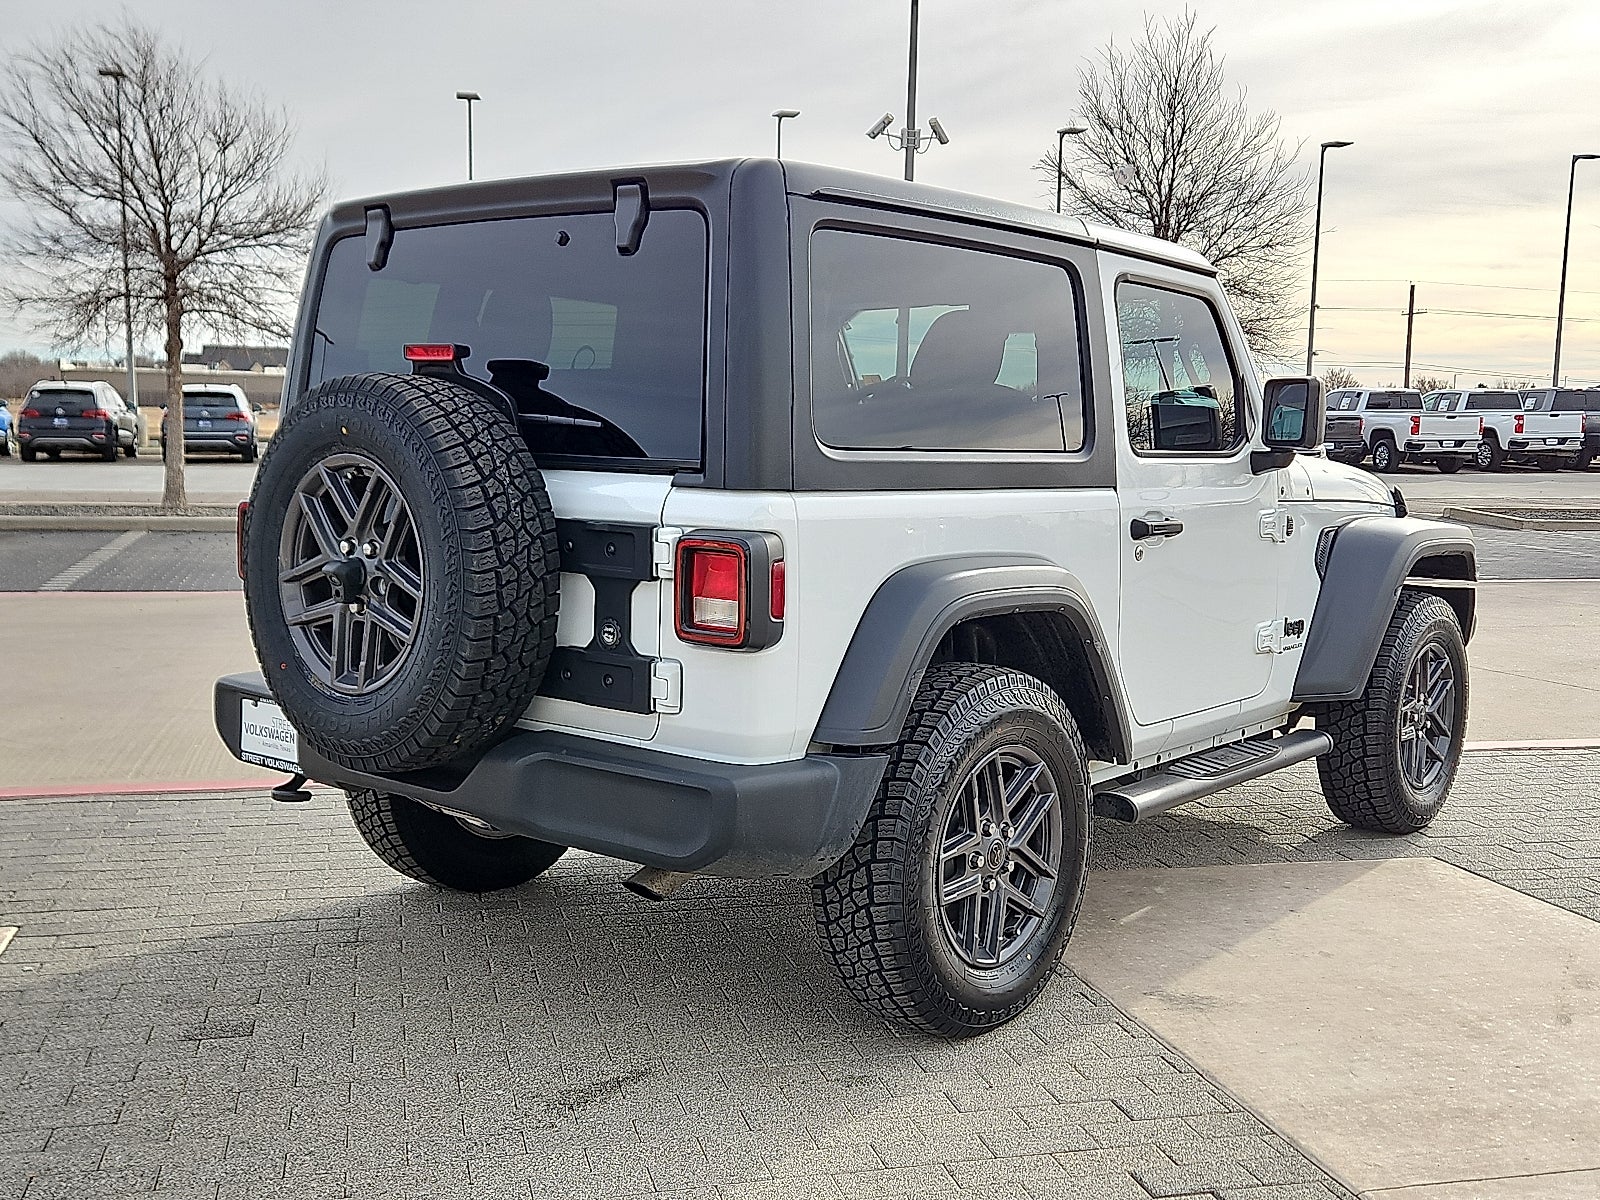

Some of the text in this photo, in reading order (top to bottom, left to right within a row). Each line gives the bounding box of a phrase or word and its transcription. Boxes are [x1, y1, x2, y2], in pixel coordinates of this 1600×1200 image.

[1284, 617, 1304, 639] Jeep
[244, 722, 295, 744] VOLKSWAGEN
[241, 752, 265, 765] STREET
